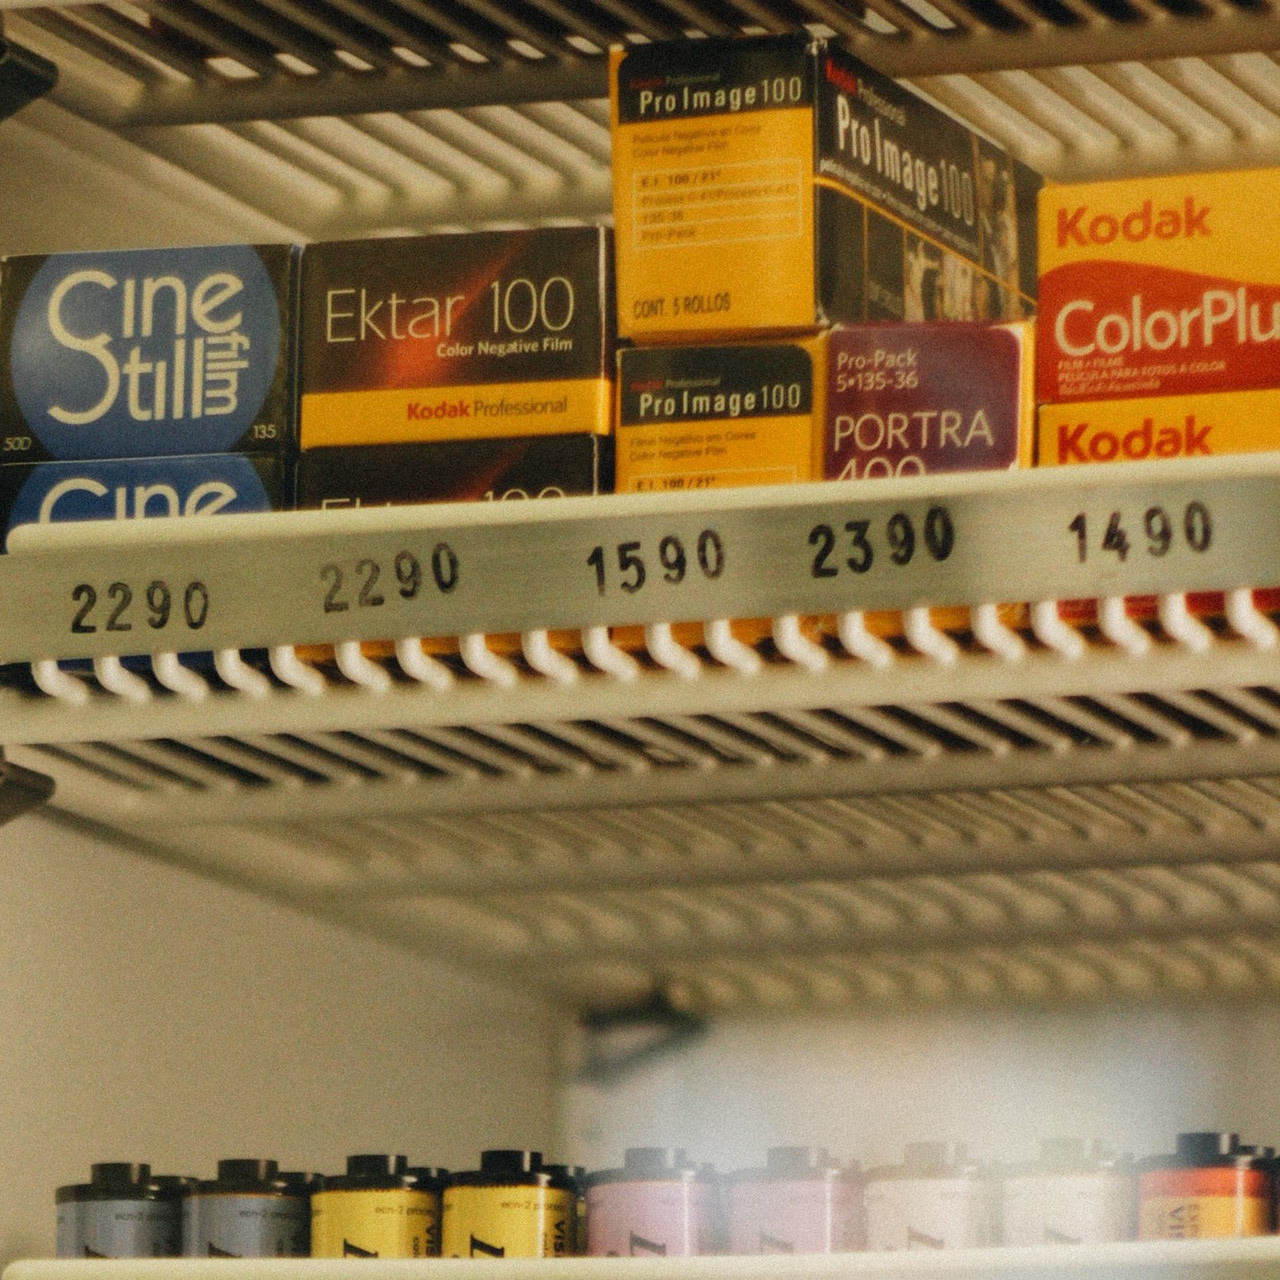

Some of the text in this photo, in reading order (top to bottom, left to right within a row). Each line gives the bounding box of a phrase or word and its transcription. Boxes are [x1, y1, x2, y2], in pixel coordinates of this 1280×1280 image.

[762, 77, 801, 101] 100
[940, 159, 974, 226] 100
[1057, 196, 1212, 248] Kodak
[47, 270, 244, 344] Cine
[326, 276, 574, 342] Ektar 100
[683, 292, 730, 312] ROLLOS
[204, 331, 250, 416] film
[437, 338, 572, 357] Color Negative Film
[837, 348, 917, 370] Pro-Pack
[47, 337, 205, 425] Still
[761, 384, 800, 408] 100
[254, 425, 276, 439] 135
[407, 397, 567, 420] Kodak Professional
[834, 409, 995, 452] PORTRA
[1058, 414, 1212, 465] Kodak
[809, 505, 956, 579] 2390
[1068, 500, 1212, 563] 1490
[319, 541, 460, 615] 2290
[587, 527, 725, 597] 1590
[71, 580, 210, 635] 2290
